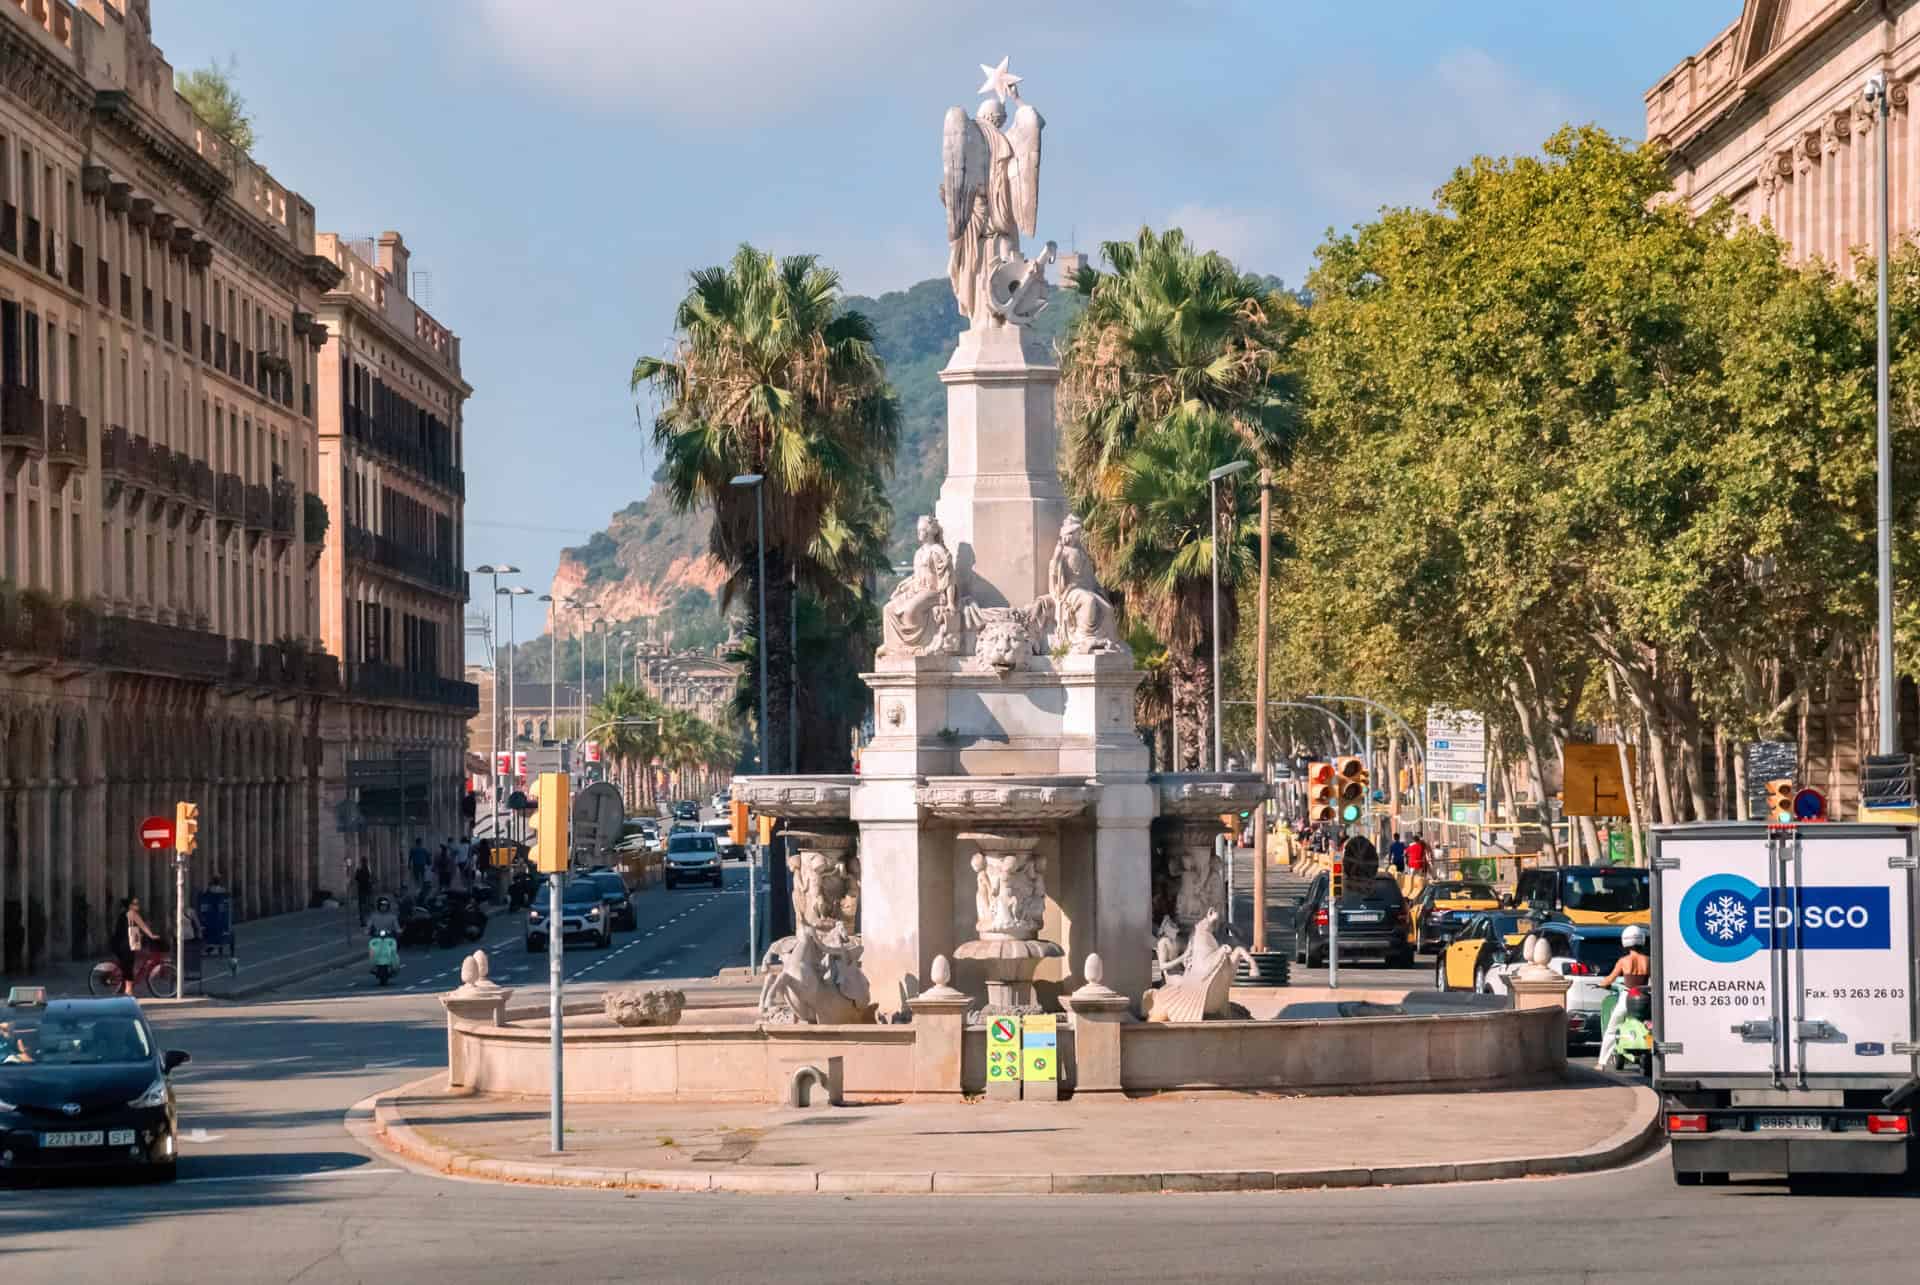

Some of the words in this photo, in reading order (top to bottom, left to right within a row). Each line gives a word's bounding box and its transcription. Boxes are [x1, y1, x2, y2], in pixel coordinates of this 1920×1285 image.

[1669, 980, 1766, 991] MERCABARNA
[1805, 988, 1829, 999] Fax.
[1832, 988, 1847, 999] 93
[1850, 988, 1870, 999] 263
[1873, 988, 1888, 999] 26
[1890, 988, 1904, 999] 03
[1668, 995, 1689, 1006] Tel.
[1692, 995, 1706, 1006] 93
[1710, 995, 1731, 1006] 263
[1734, 995, 1749, 1006] 00
[1752, 995, 1765, 1006] 01
